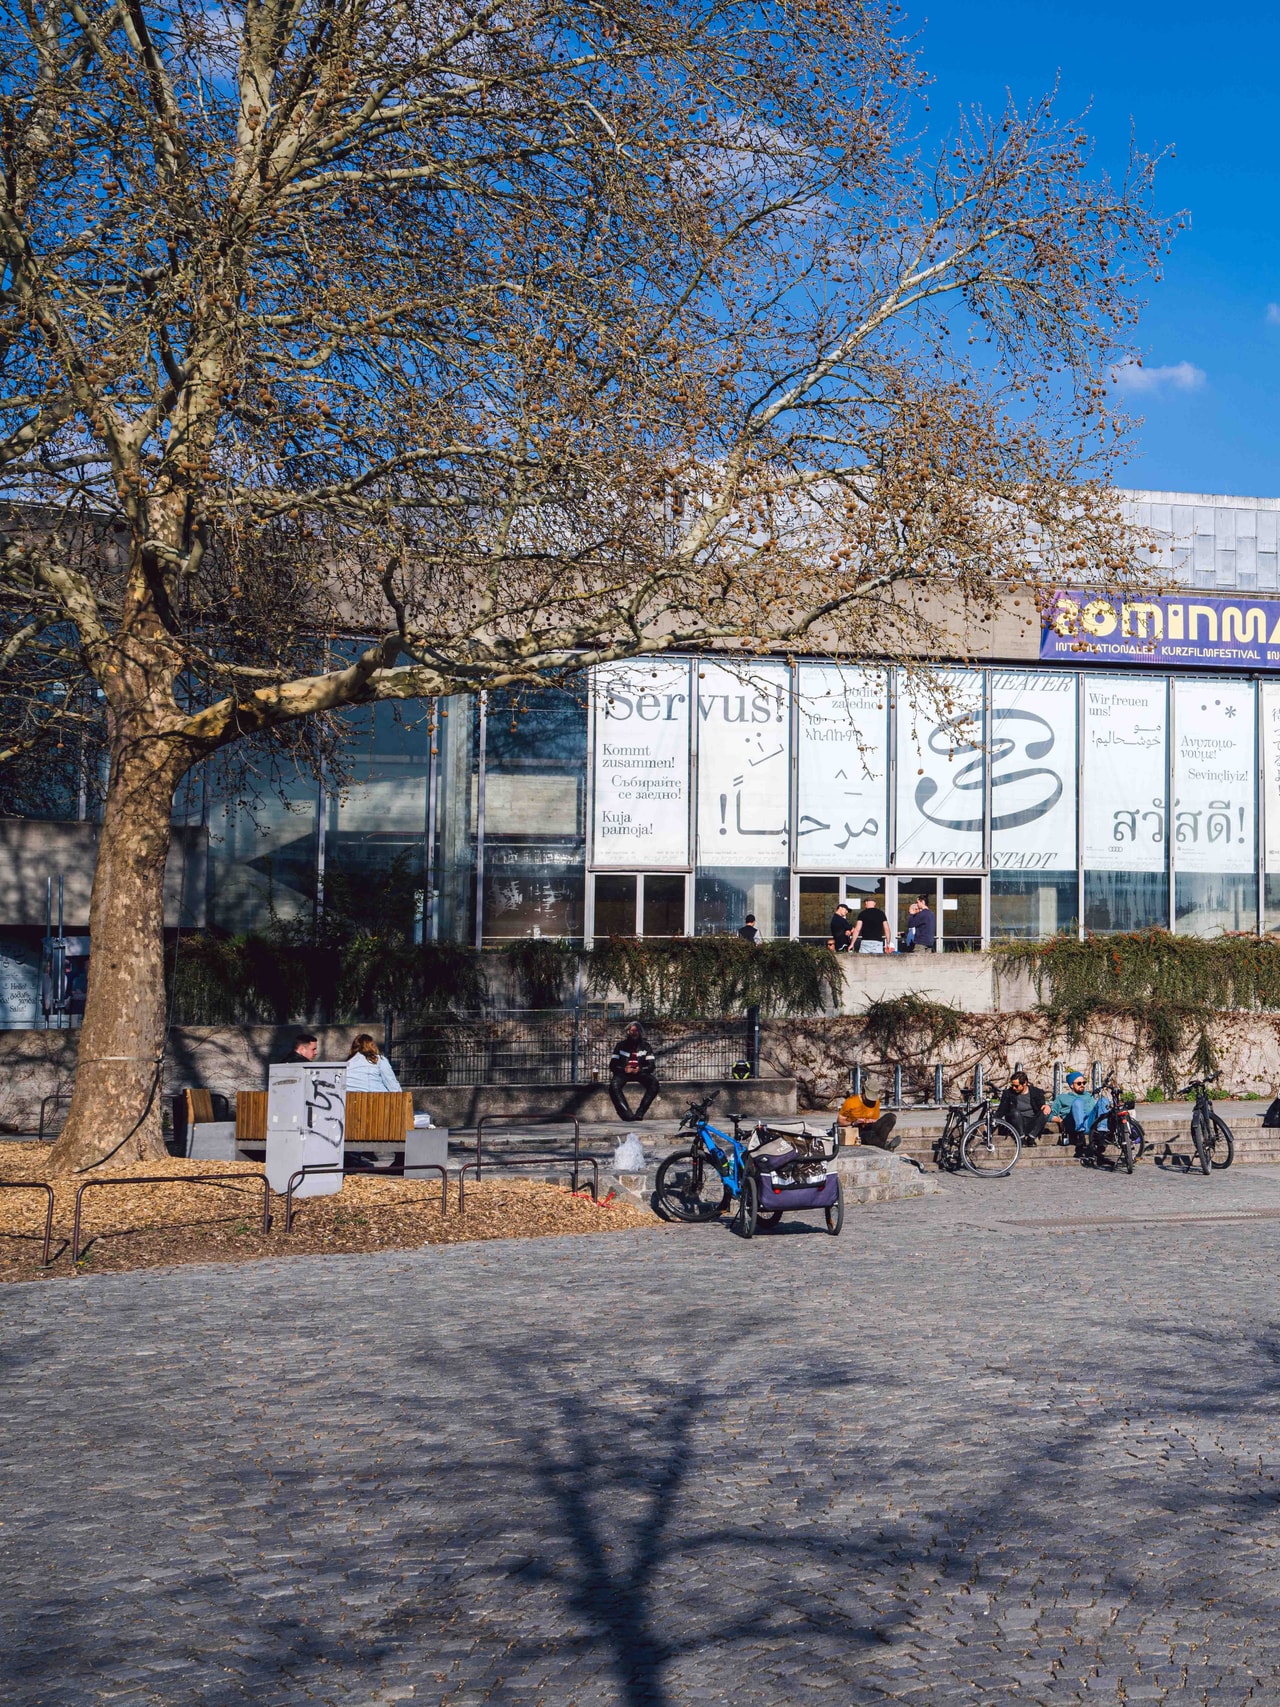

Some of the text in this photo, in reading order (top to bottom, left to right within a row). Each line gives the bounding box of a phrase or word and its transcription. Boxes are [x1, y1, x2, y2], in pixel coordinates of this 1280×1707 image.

[1055, 641, 1155, 655] INTNATIONALES
[1161, 646, 1261, 659] KURZFILMFESTIVAL
[604, 679, 783, 724] Servus!
[1089, 692, 1149, 706] Wir freuen
[1088, 705, 1111, 717] uns!
[602, 743, 651, 756] Kommt
[602, 756, 675, 769] zusammen!
[611, 774, 682, 791] Събирайте
[635, 787, 682, 801] заедно!
[602, 810, 632, 825] Kuja
[602, 823, 653, 838] pamoja!
